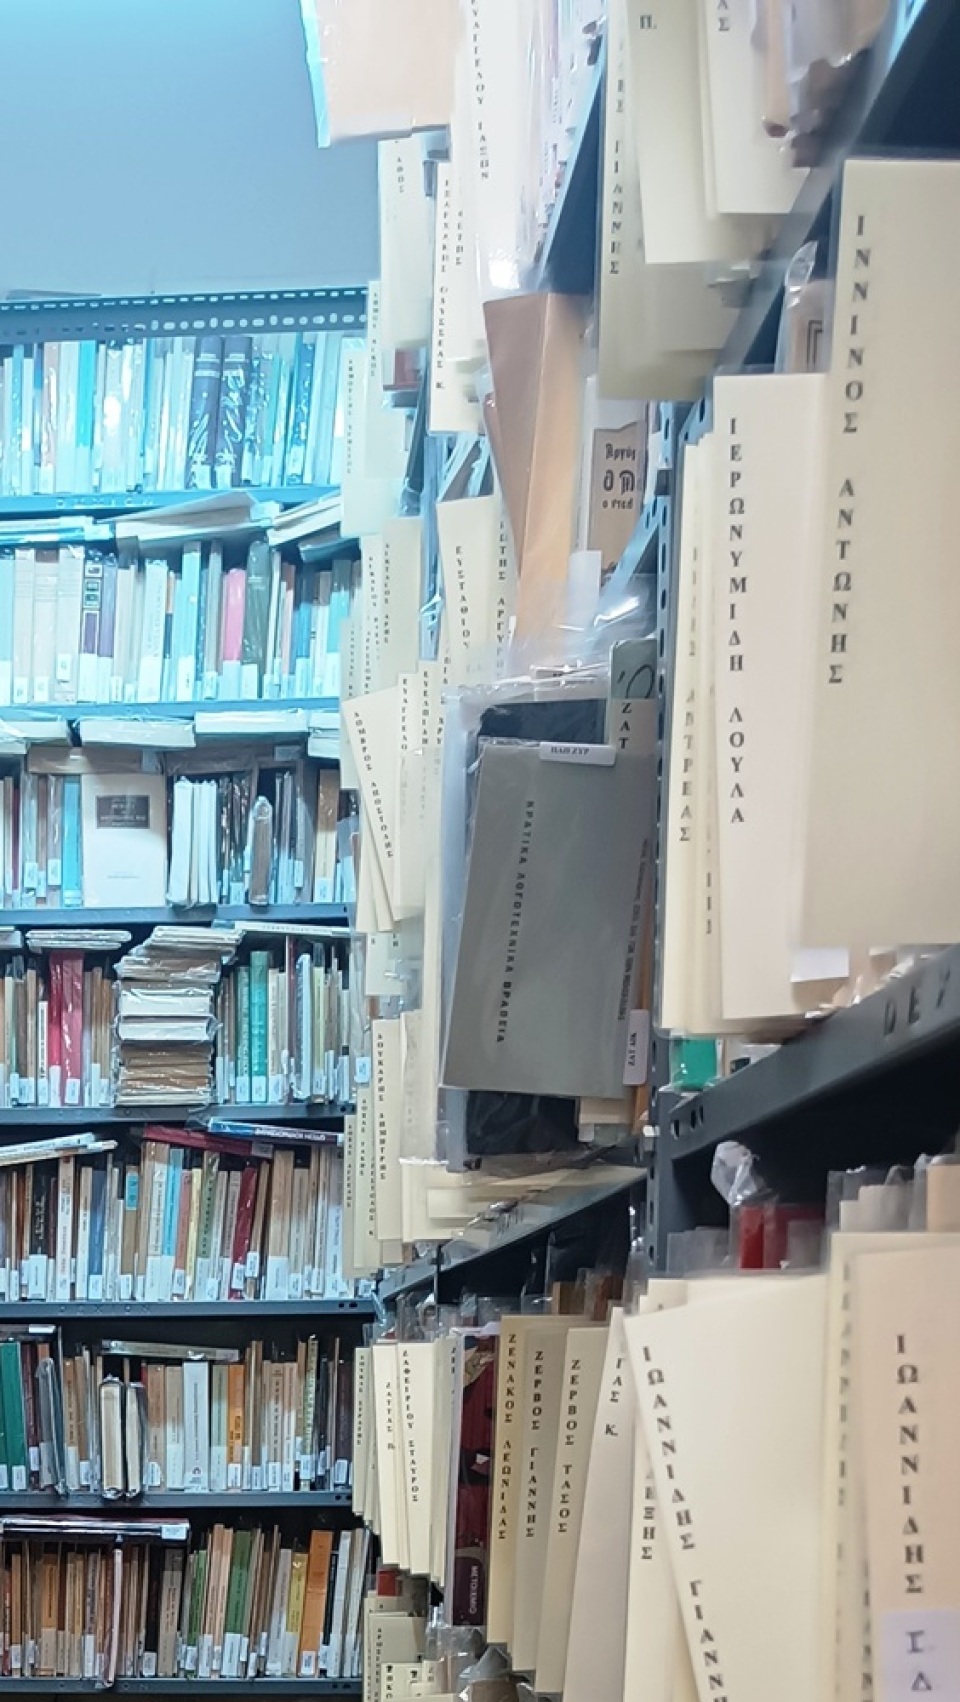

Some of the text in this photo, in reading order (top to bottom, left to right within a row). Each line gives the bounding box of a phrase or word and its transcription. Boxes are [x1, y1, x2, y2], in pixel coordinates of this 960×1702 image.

[729, 418, 747, 672] ΙΕΡΩΝΥΜΙΔΗ
[828, 478, 854, 684] ΑΝΤΩΝΗΣ
[526, 1448, 538, 1537] ΓΙΑΝΝΗΣ
[643, 1346, 696, 1550] ΙΩΑΝΝΙΔΗΣ
[896, 1334, 924, 1594] ΙΩΑΝΝΙΔΗΣ
